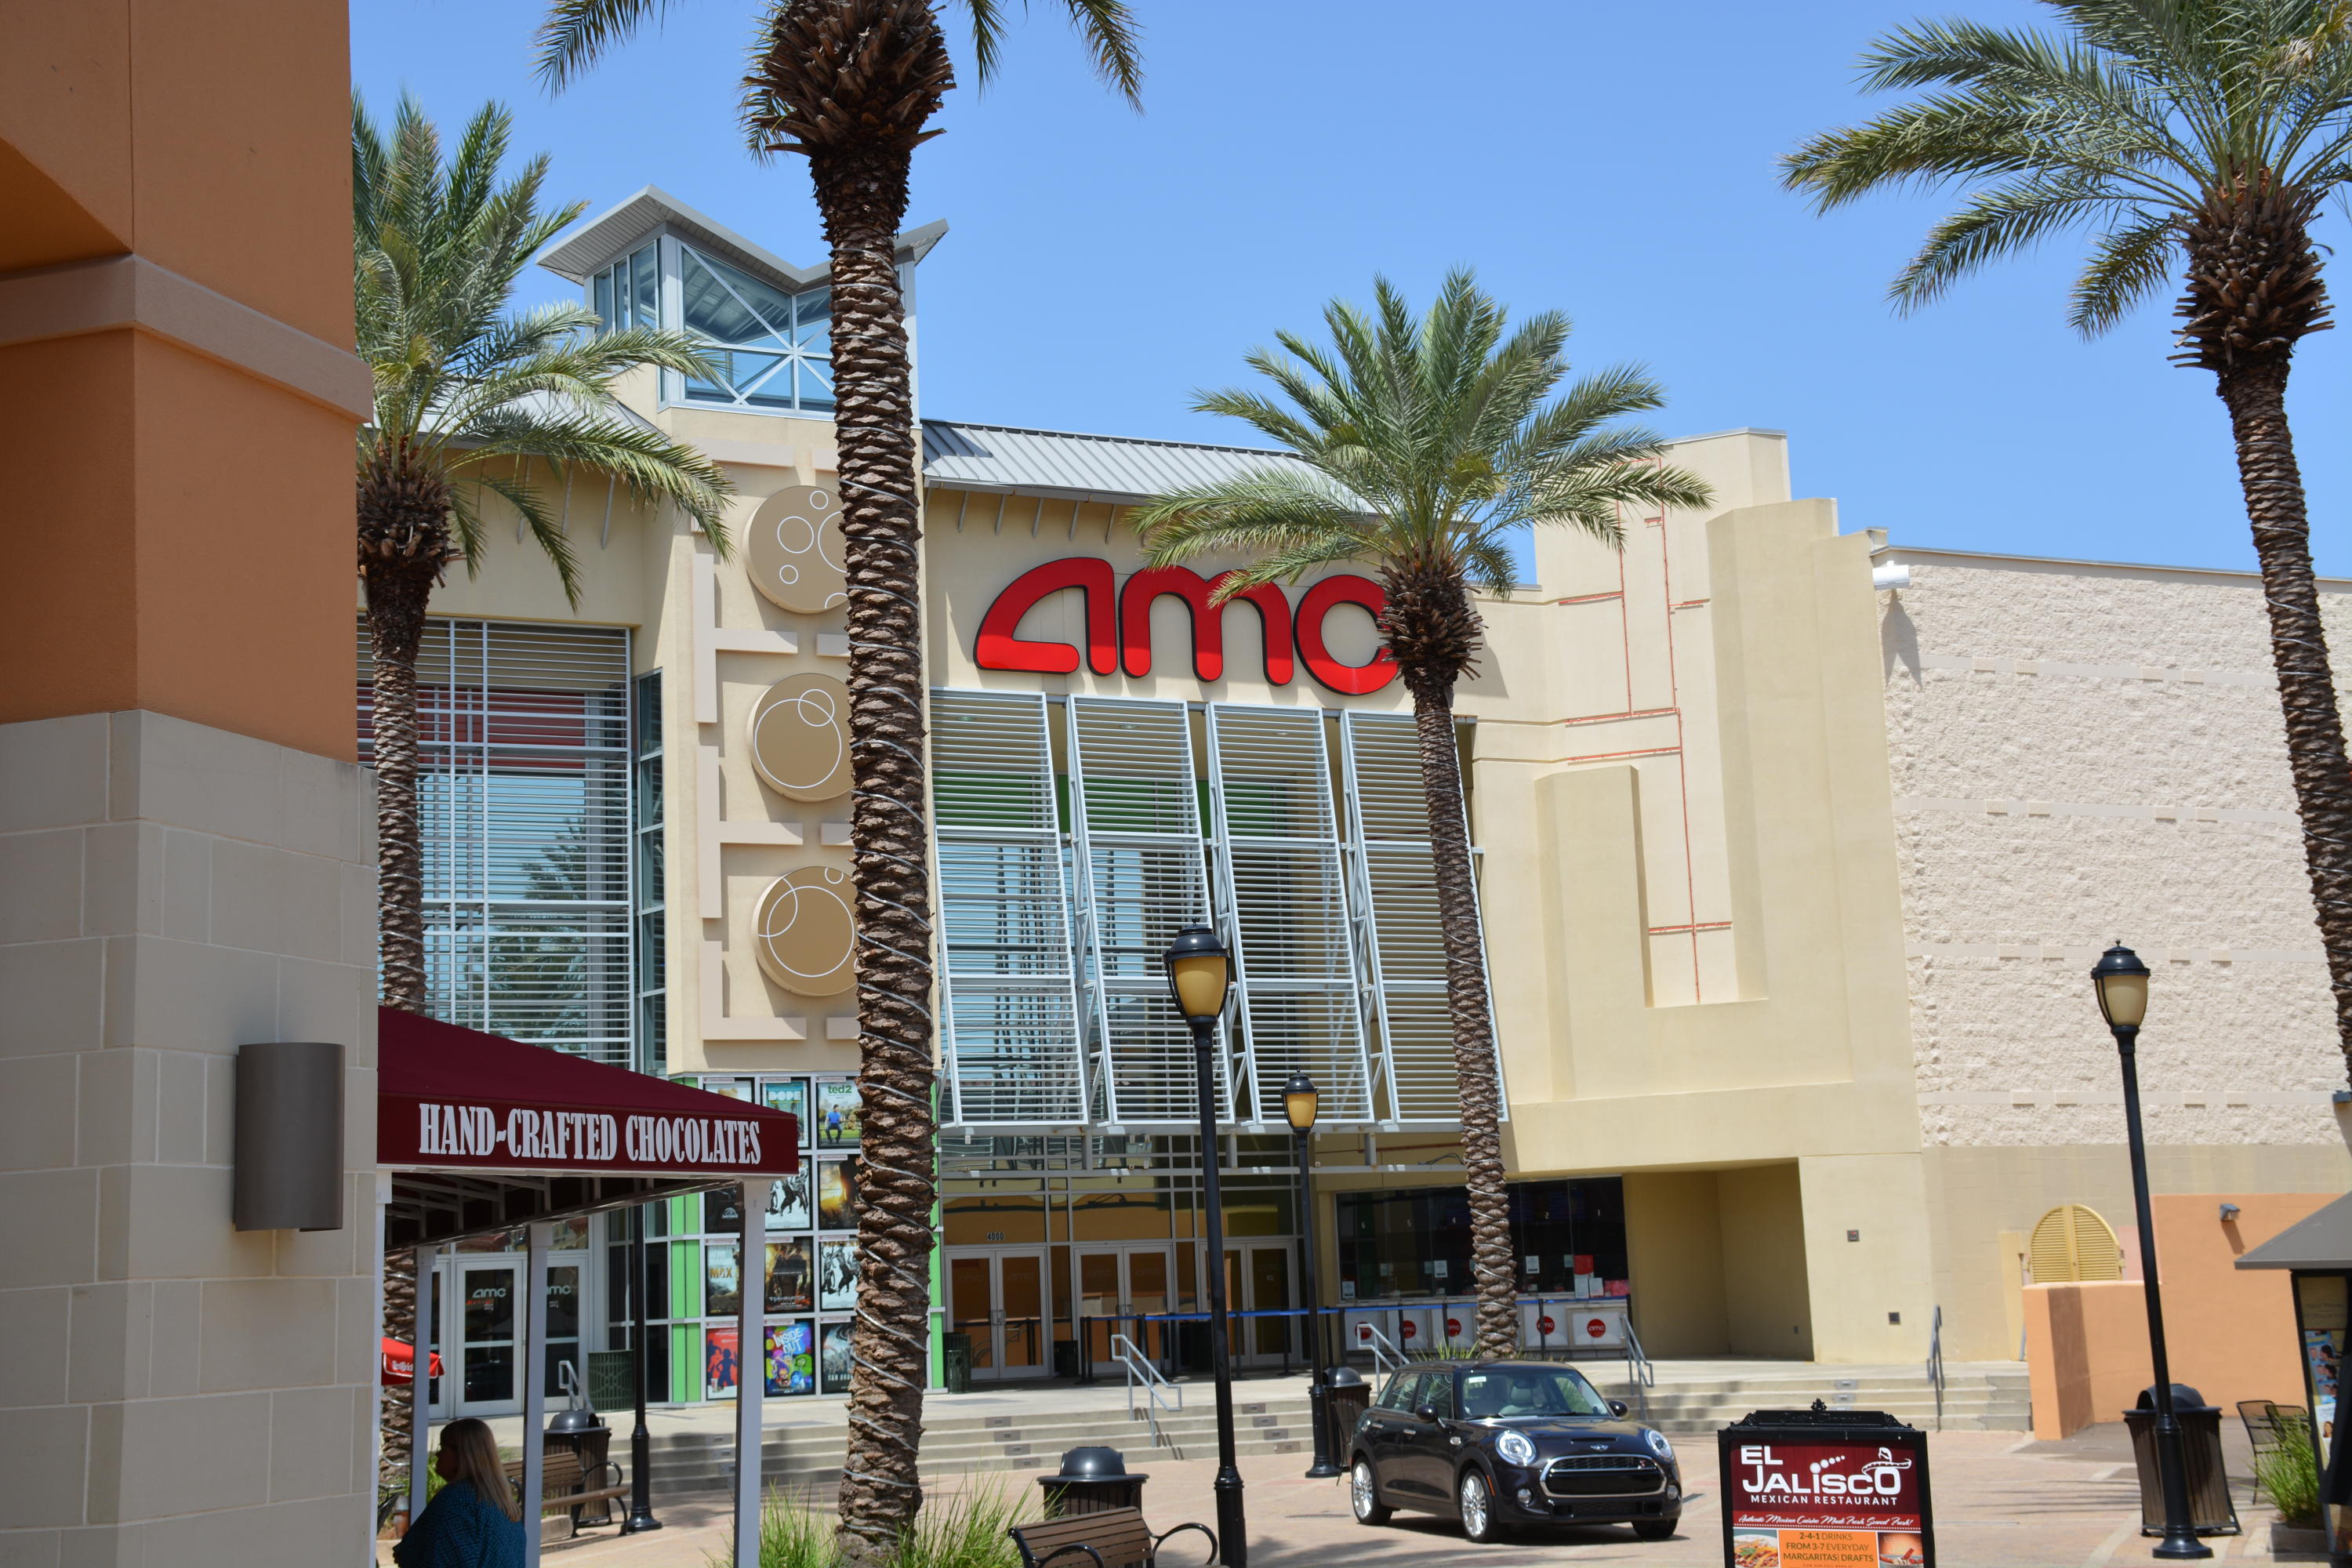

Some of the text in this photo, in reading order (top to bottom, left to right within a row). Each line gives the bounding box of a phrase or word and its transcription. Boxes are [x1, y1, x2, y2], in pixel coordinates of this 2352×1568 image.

[768, 1091, 801, 1101] DOPE
[419, 1103, 761, 1165] HAND-CRAFTED CHOCOLATES
[987, 1232, 1004, 1240] 4000
[710, 1267, 732, 1279] MAX
[772, 1327, 804, 1348] INSIDE
[783, 1341, 801, 1354] OUT
[1740, 1445, 1784, 1465] EL
[1751, 1494, 1898, 1506] MEXICAN RESTAURANT
[1826, 1543, 1869, 1552] EVERYDAY
[1841, 1554, 1874, 1563] DRAFTS
